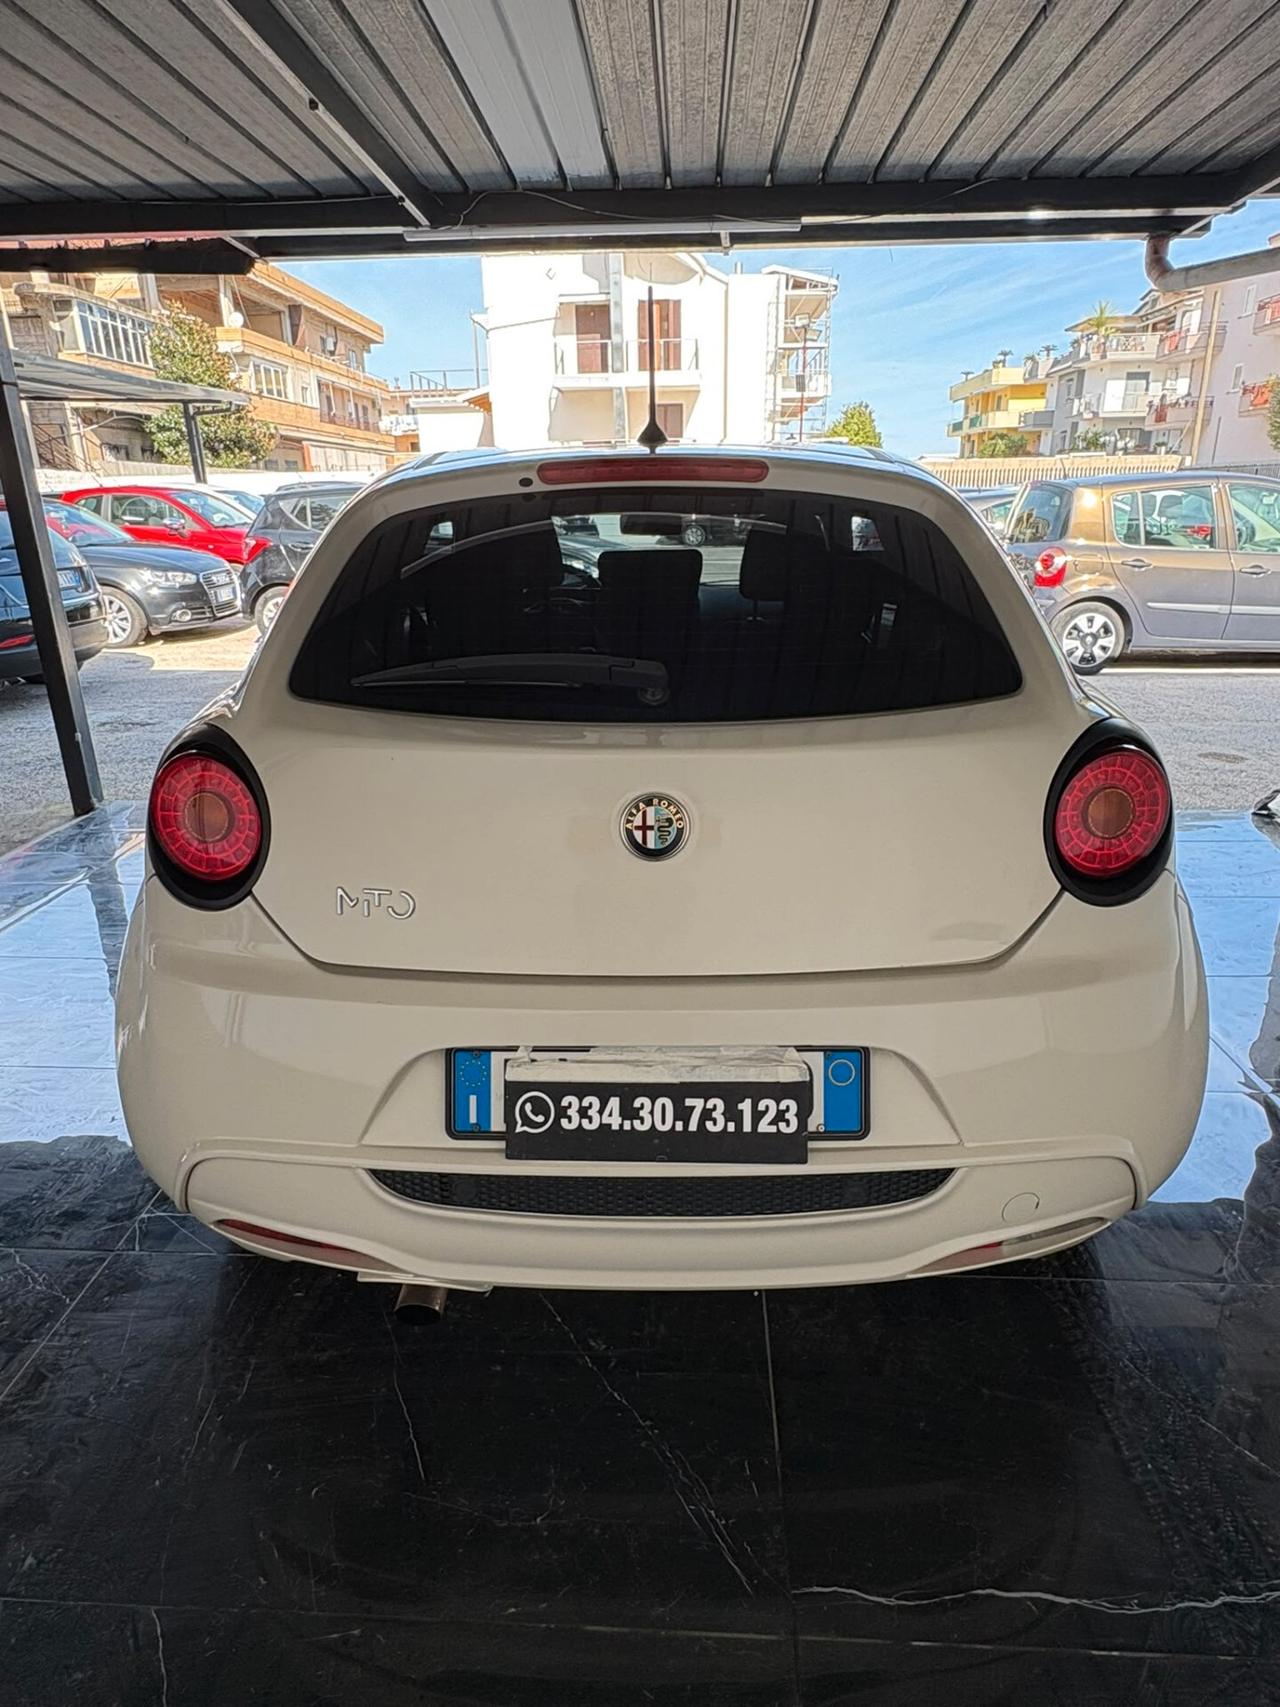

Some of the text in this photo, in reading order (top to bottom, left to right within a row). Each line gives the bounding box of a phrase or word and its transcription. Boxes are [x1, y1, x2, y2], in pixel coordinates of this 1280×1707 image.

[625, 799, 684, 829] ALFA ROMEO
[469, 1094, 477, 1124] I
[560, 1095, 798, 1134] 334.30.73.123
